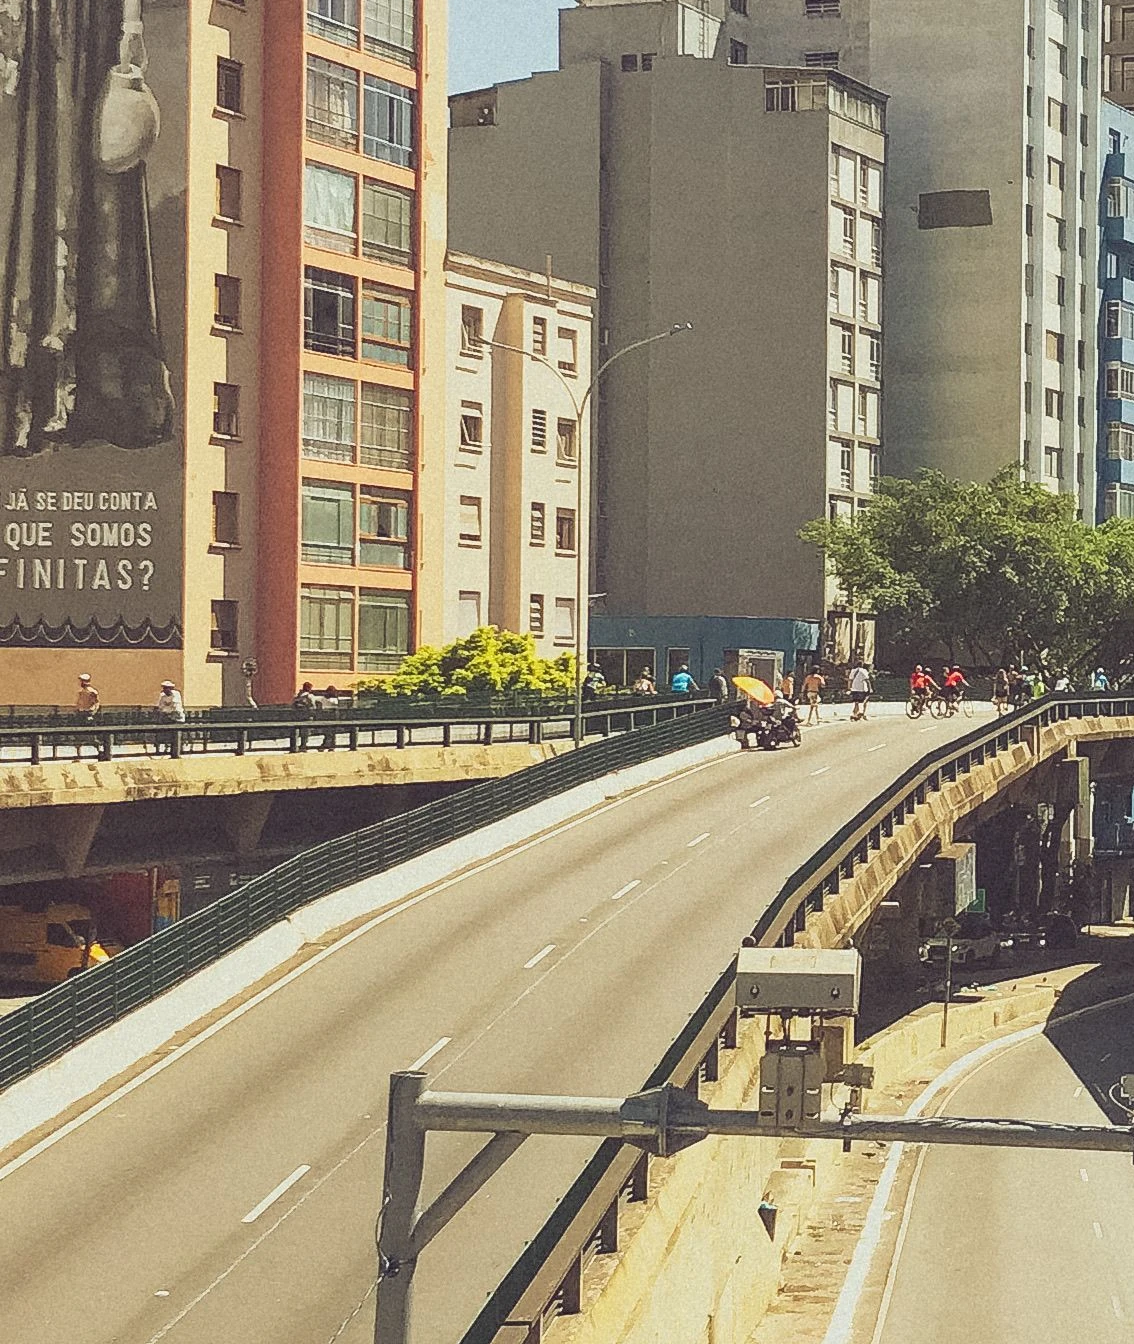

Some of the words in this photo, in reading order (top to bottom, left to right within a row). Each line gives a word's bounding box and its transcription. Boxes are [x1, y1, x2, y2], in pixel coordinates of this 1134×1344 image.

[36, 491, 57, 511] SE
[62, 491, 94, 511] DEU
[100, 491, 158, 511] CONTA
[5, 522, 53, 550] QUE
[71, 522, 152, 547] SOMOS
